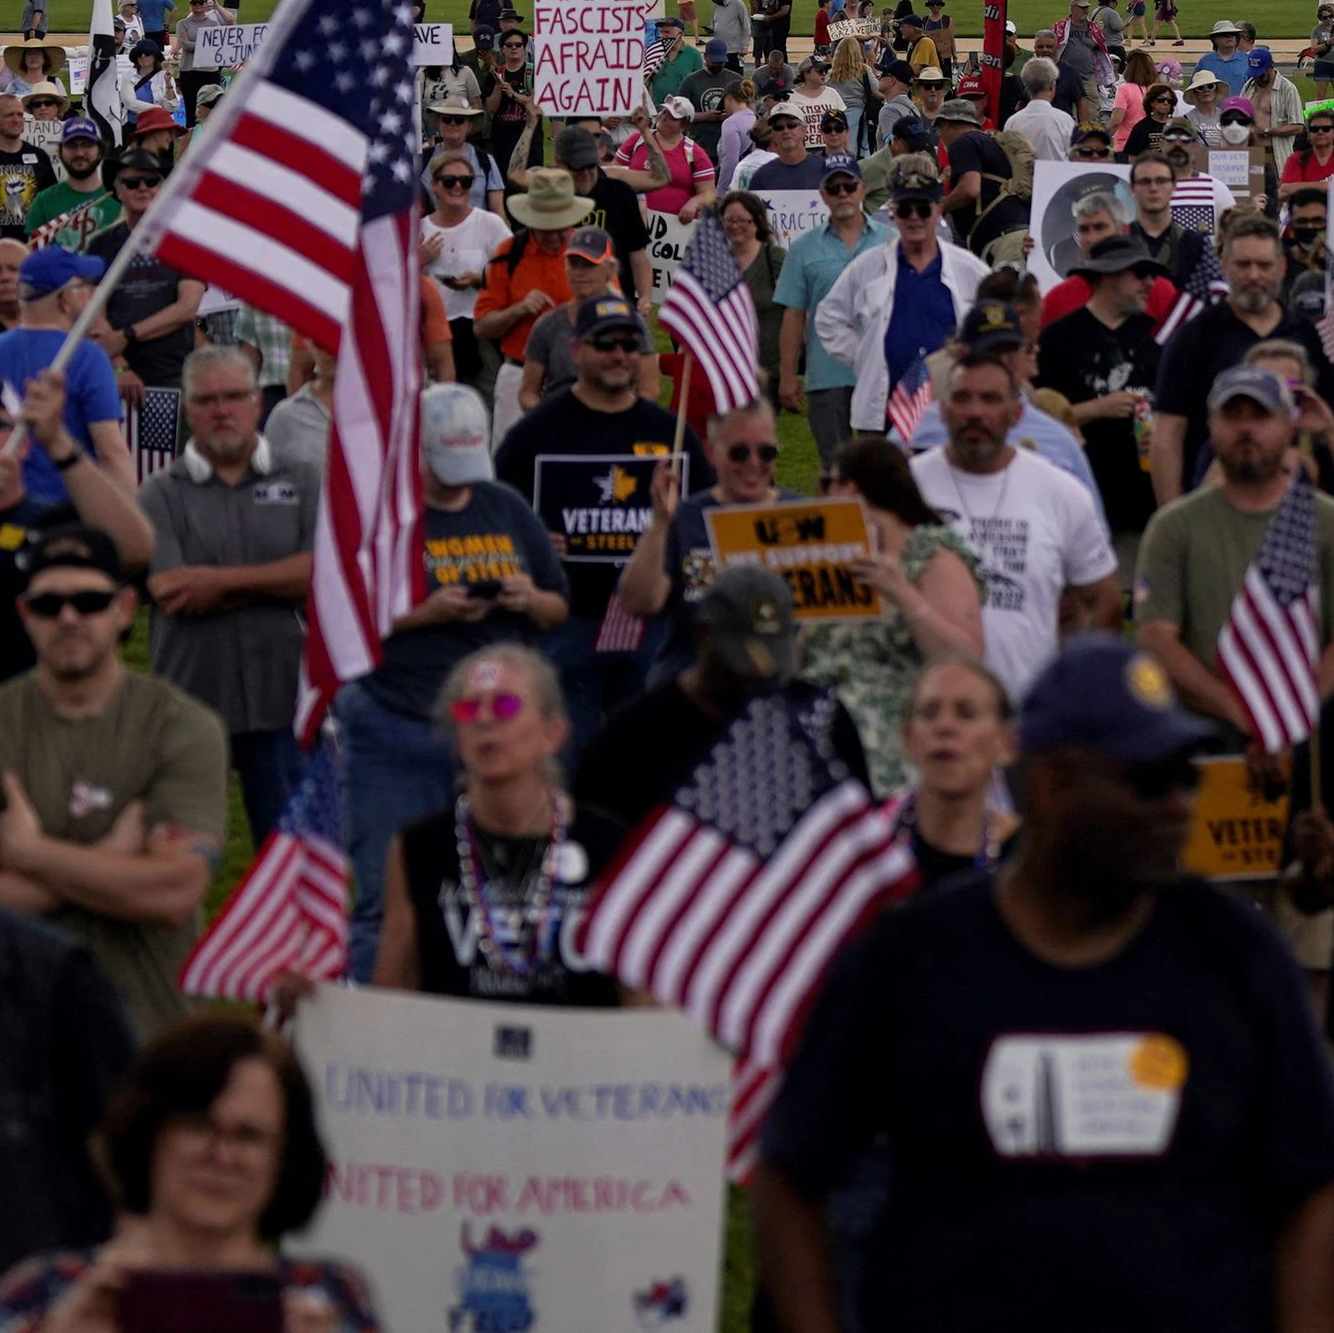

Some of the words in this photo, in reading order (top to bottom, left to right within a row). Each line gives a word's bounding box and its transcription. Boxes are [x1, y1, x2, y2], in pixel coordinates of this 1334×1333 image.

[536, 6, 646, 35] FASCISTS
[203, 27, 245, 48] NEVER
[830, 27, 855, 40] GAZA
[536, 38, 644, 76] AFRAID
[537, 77, 633, 113] AGAIN
[27, 120, 64, 135] TAND
[825, 155, 852, 166] NAVY
[426, 534, 515, 558] WOMEN
[586, 534, 639, 551] STEEL
[768, 543, 863, 566] SUPPORT
[435, 565, 461, 585] OF
[325, 1067, 474, 1120] UNITED
[540, 1080, 726, 1121] VETERANS
[324, 1160, 445, 1214] NITED
[515, 1176, 693, 1215] AMERICA
